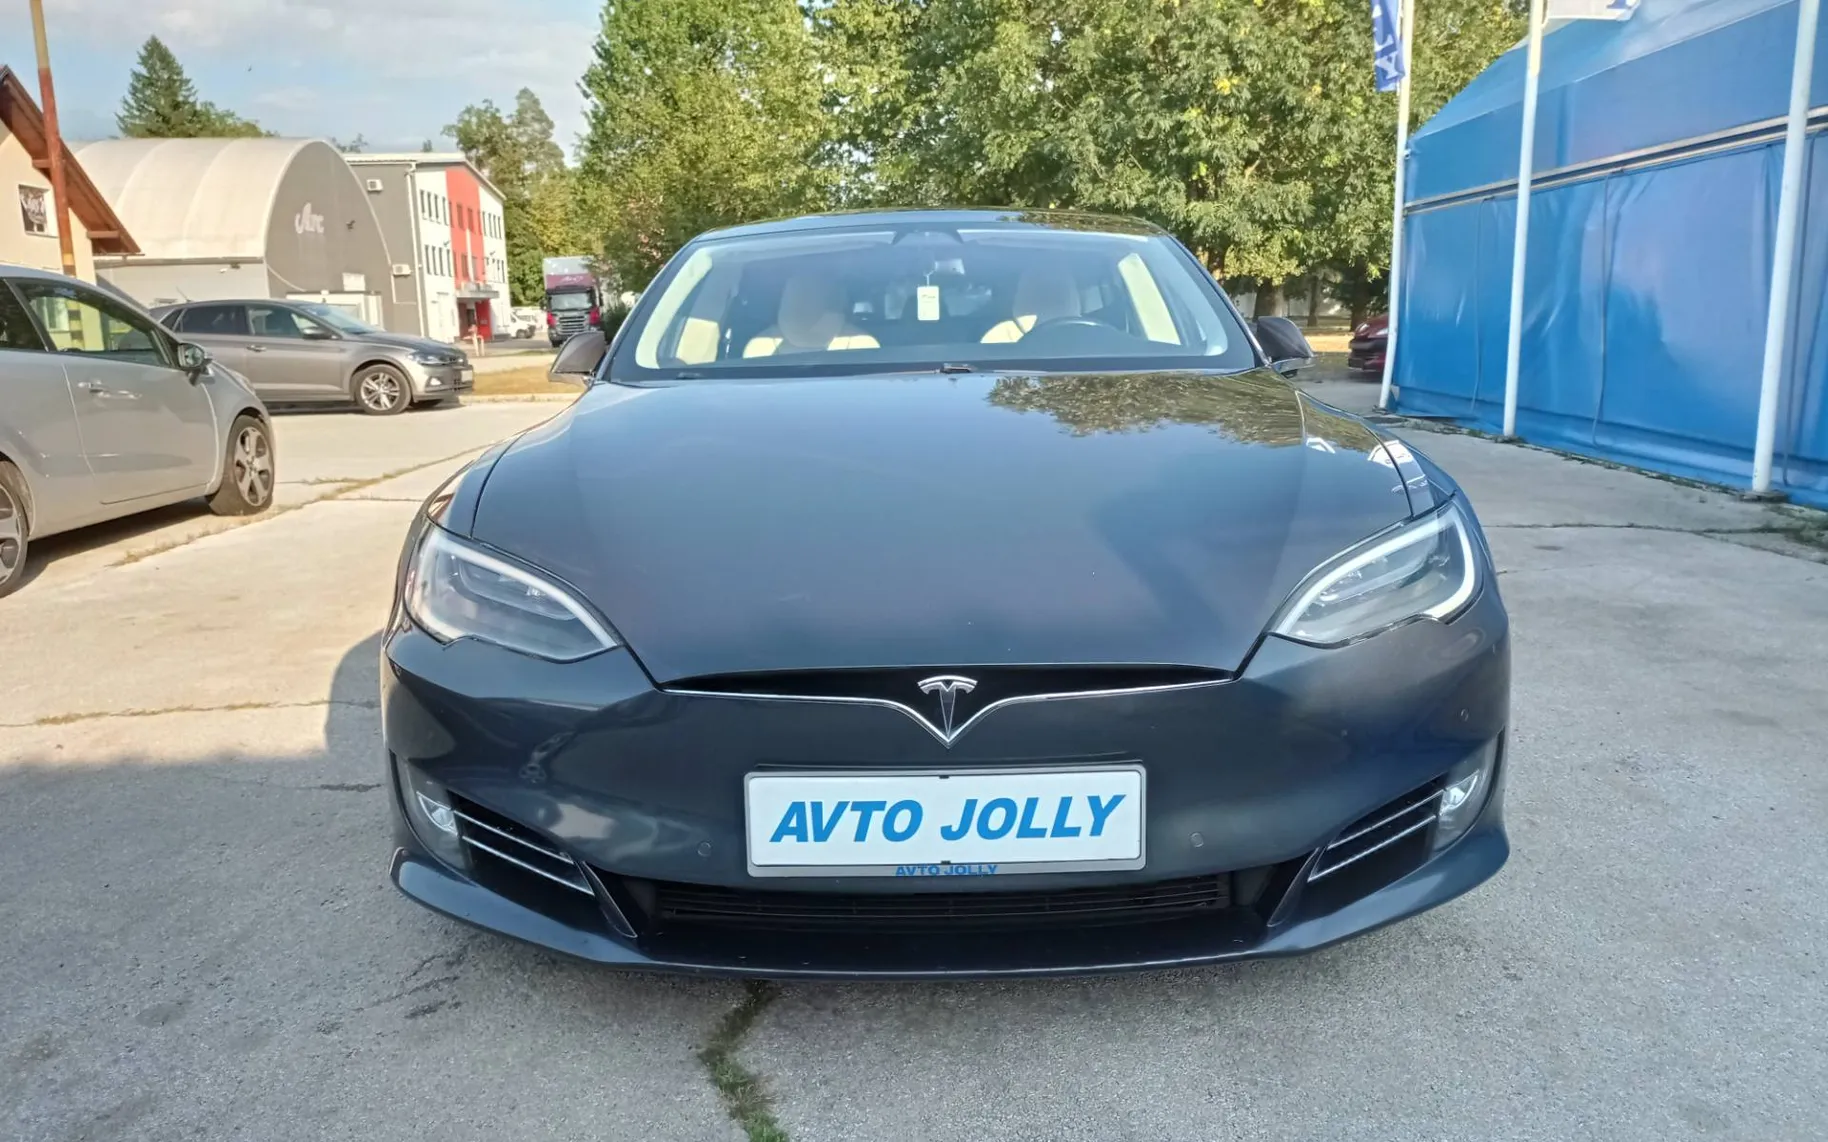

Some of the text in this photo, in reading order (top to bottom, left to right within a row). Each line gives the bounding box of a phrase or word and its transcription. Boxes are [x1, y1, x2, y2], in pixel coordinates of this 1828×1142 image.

[769, 794, 1127, 843] AVTO JOLLY
[895, 863, 998, 876] AVTO JOLLY
